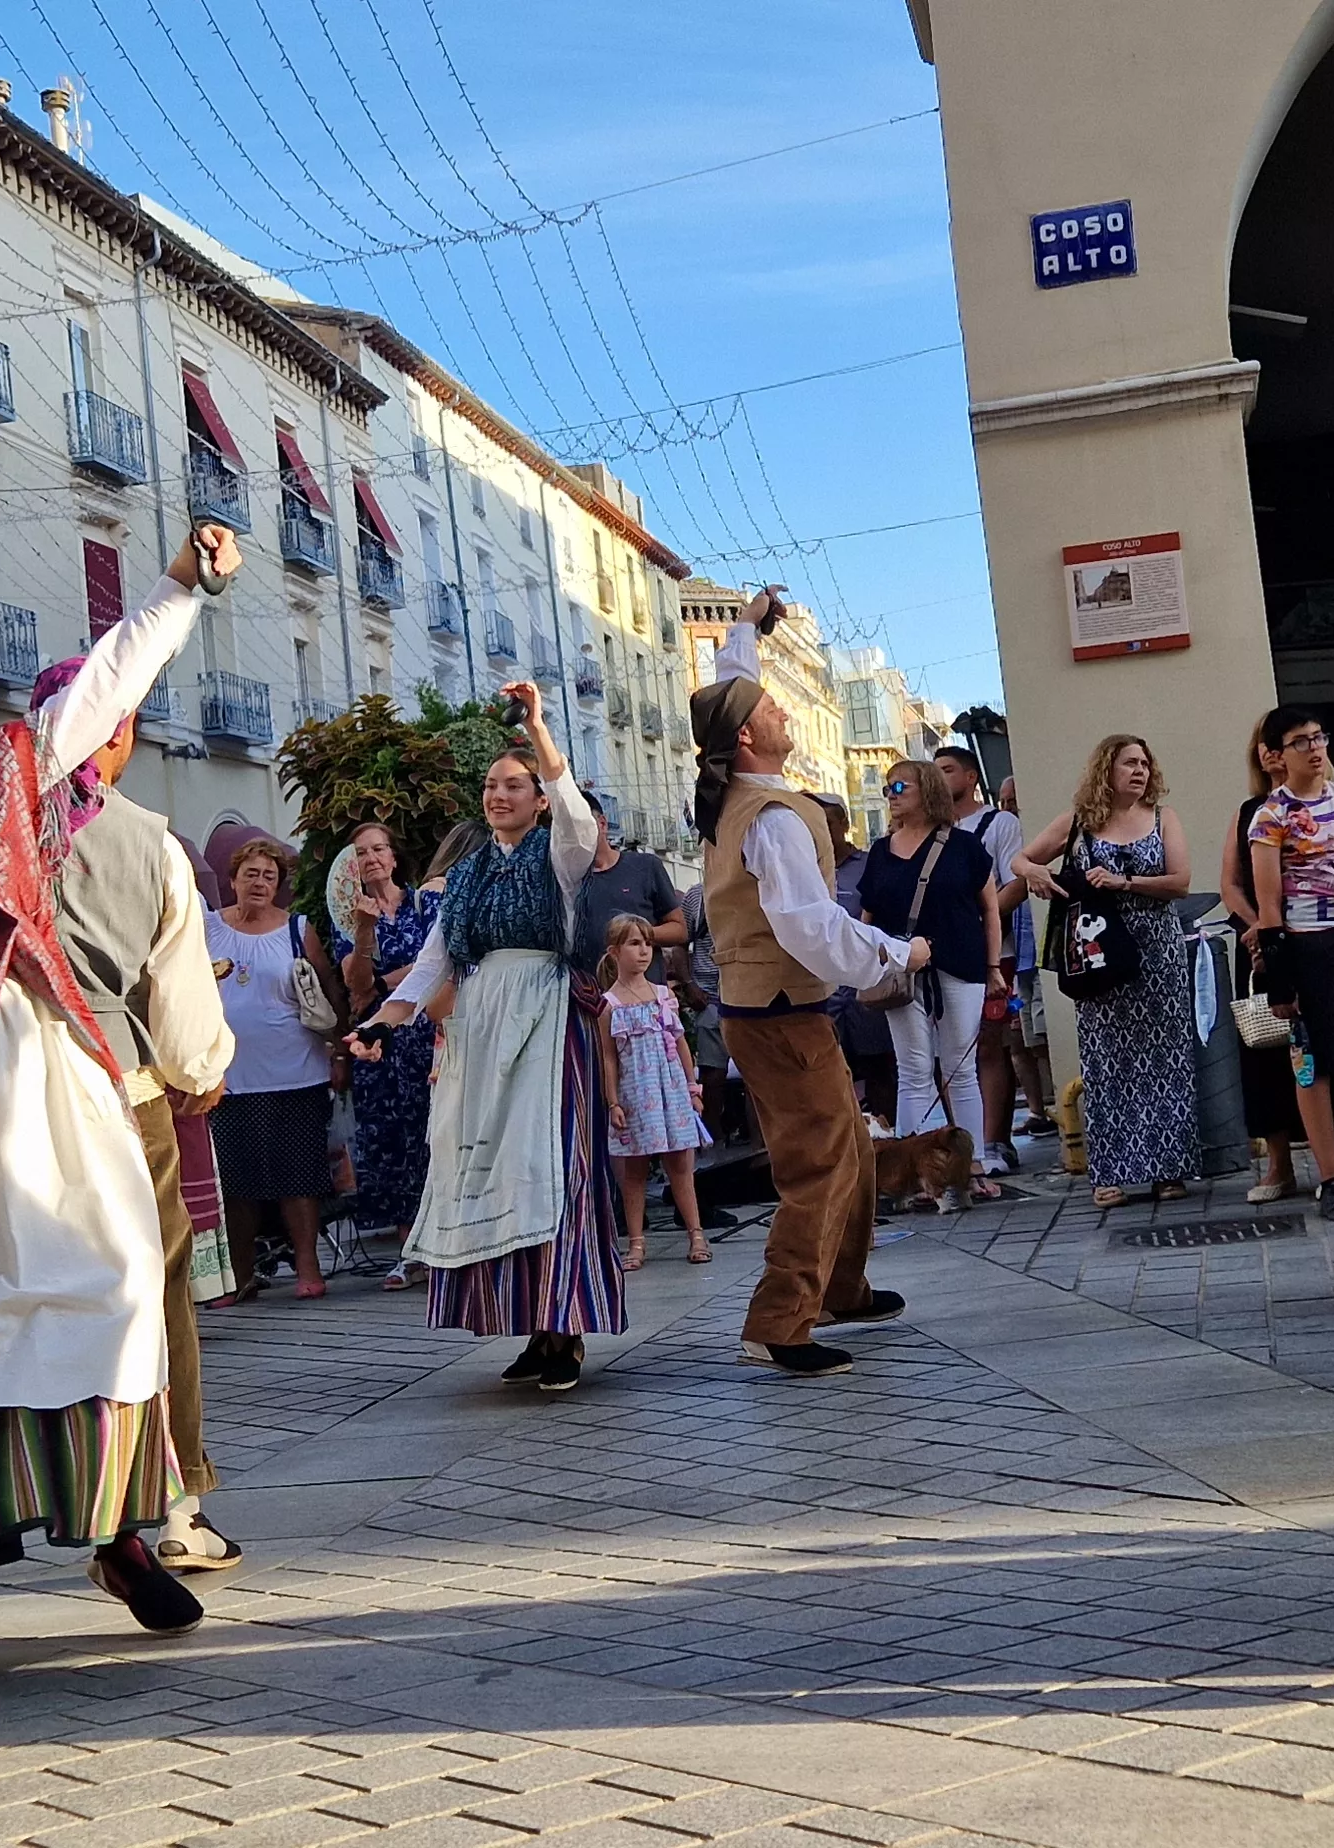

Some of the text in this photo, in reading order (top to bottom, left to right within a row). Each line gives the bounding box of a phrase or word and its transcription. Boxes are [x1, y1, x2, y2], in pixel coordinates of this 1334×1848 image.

[1039, 212, 1124, 243] COSO
[1042, 245, 1127, 276] ALTO
[1102, 539, 1142, 551] COSO ALTO
